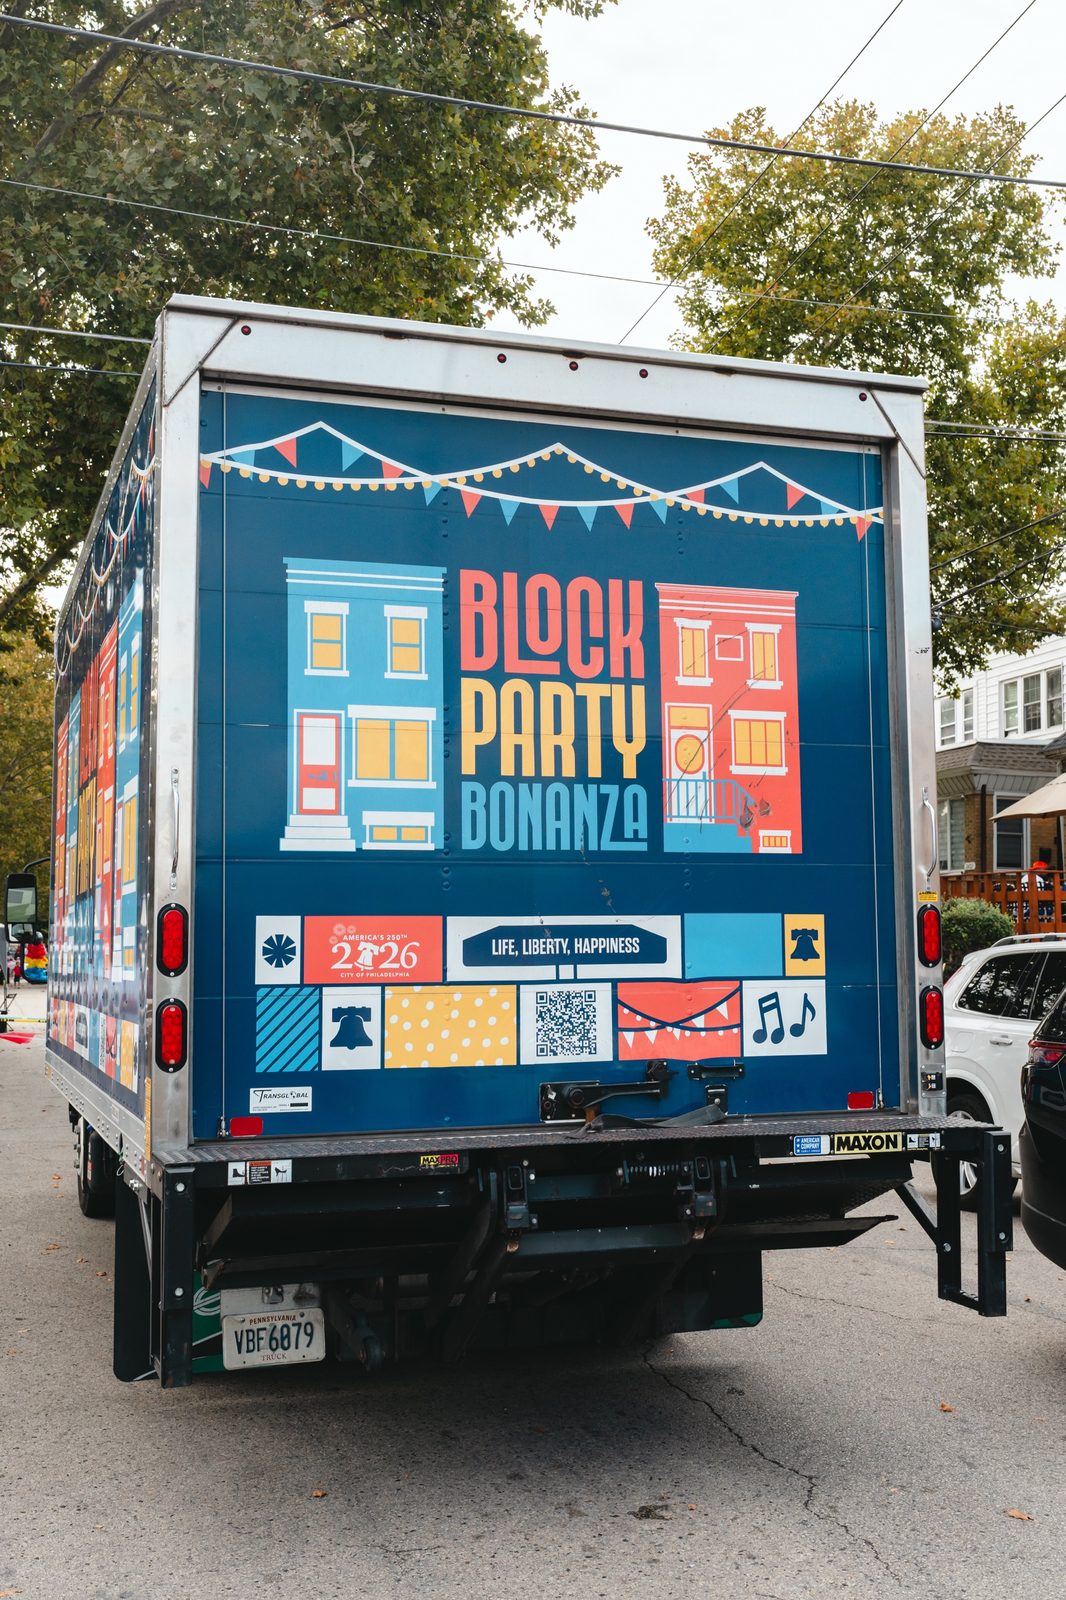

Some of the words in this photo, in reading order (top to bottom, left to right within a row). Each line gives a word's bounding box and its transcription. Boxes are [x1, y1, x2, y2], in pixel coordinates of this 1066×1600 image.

[459, 568, 645, 679] BLOCK
[460, 677, 646, 779] PARTY
[461, 781, 648, 851] BONANZA
[491, 939, 519, 957] LIFE,
[522, 938, 571, 956] LIBERTY,
[574, 937, 640, 954] HAPPINESS
[836, 1134, 898, 1151] MAXON
[249, 1315, 297, 1325] PENNSYLVANIA
[262, 1352, 287, 1361] TRUCK
